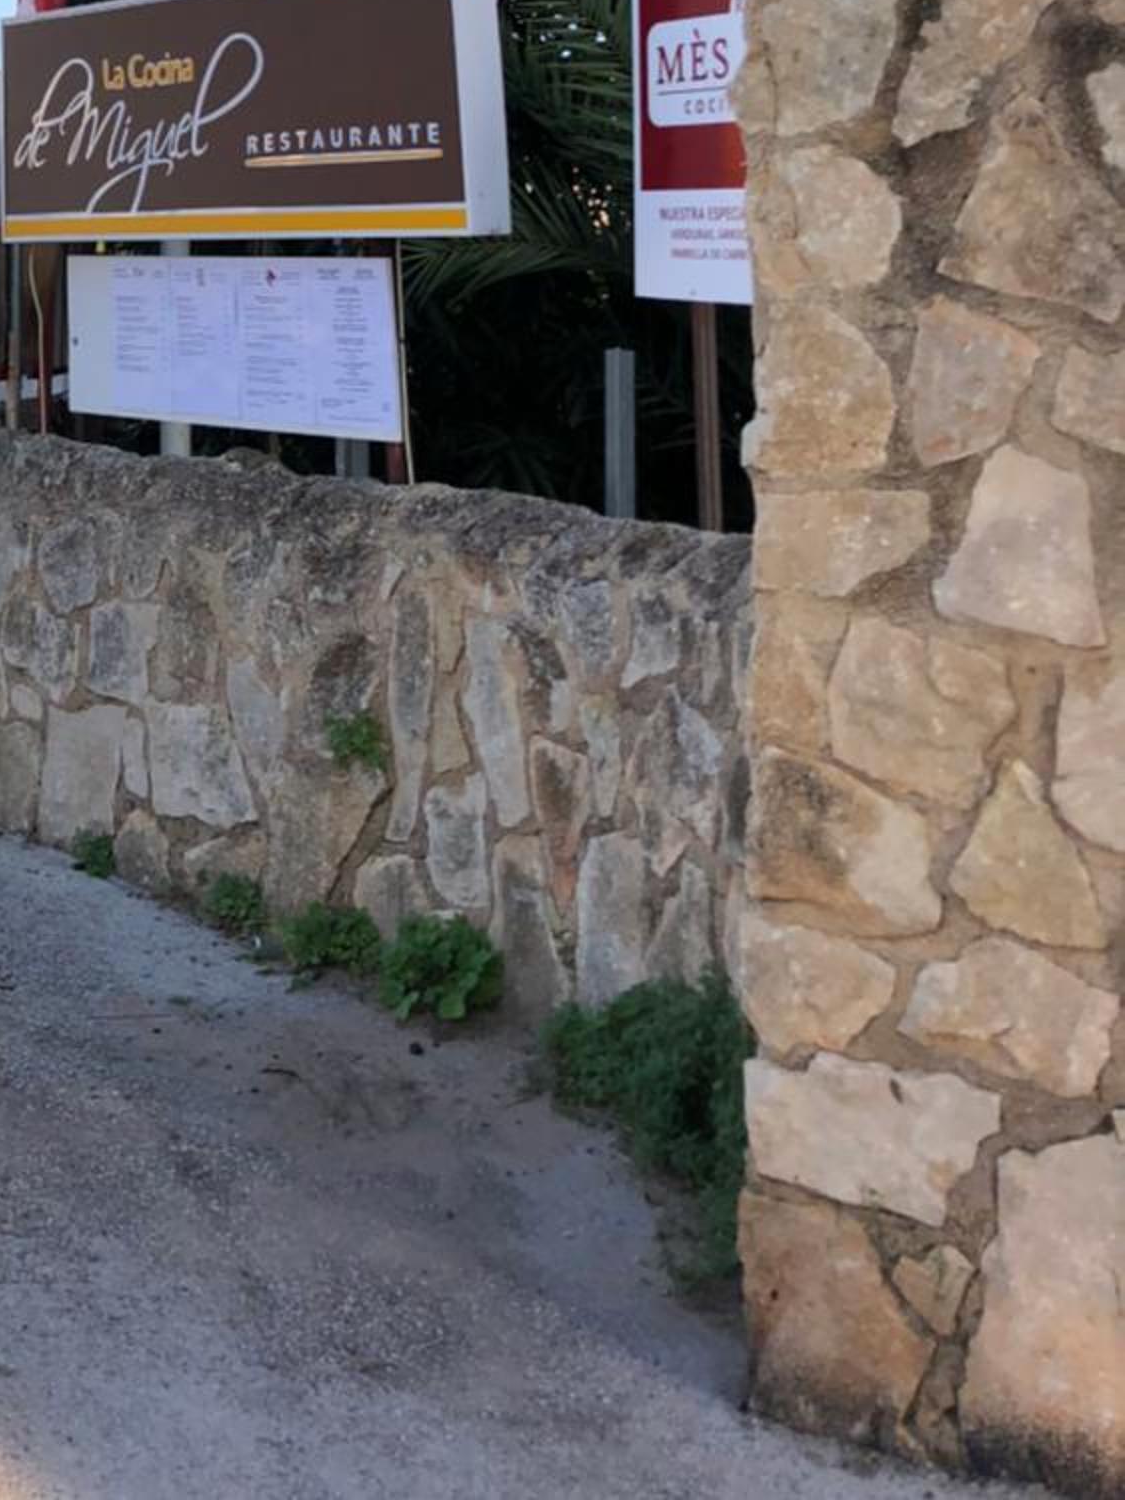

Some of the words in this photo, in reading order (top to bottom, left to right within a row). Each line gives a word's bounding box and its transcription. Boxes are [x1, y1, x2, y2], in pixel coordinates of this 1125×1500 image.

[101, 57, 125, 91] La
[127, 51, 194, 89] Cocina
[656, 27, 731, 85] MÈS
[13, 58, 94, 170] de
[58, 32, 265, 214] Miguel
[683, 98, 725, 115] COCI
[245, 121, 442, 156] RESTAURANTE
